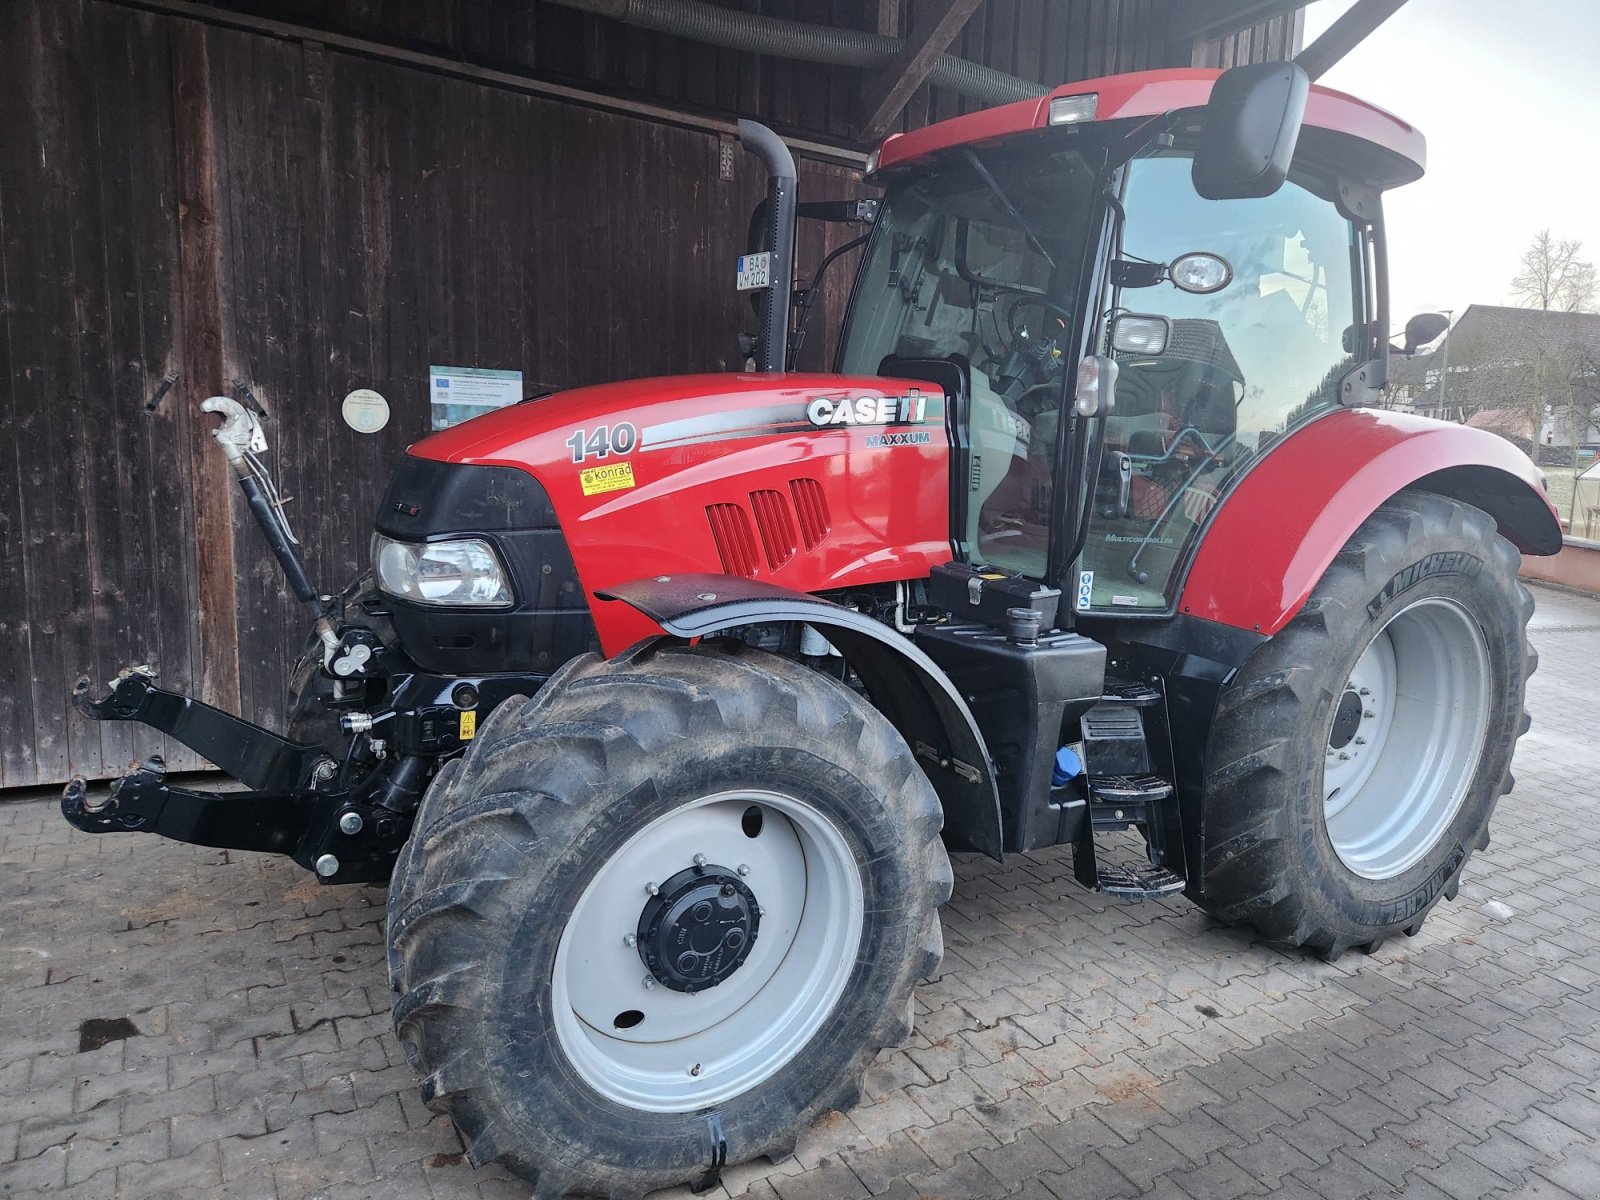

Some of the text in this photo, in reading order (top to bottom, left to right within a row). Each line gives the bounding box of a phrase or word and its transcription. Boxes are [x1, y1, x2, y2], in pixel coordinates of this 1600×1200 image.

[750, 257, 760, 271] BA
[750, 270, 766, 286] 202
[807, 396, 898, 426] CASE
[566, 421, 636, 464] 140
[866, 431, 931, 448] MAXXUM
[594, 462, 631, 480] konrad
[1392, 552, 1484, 595] MICHELIN
